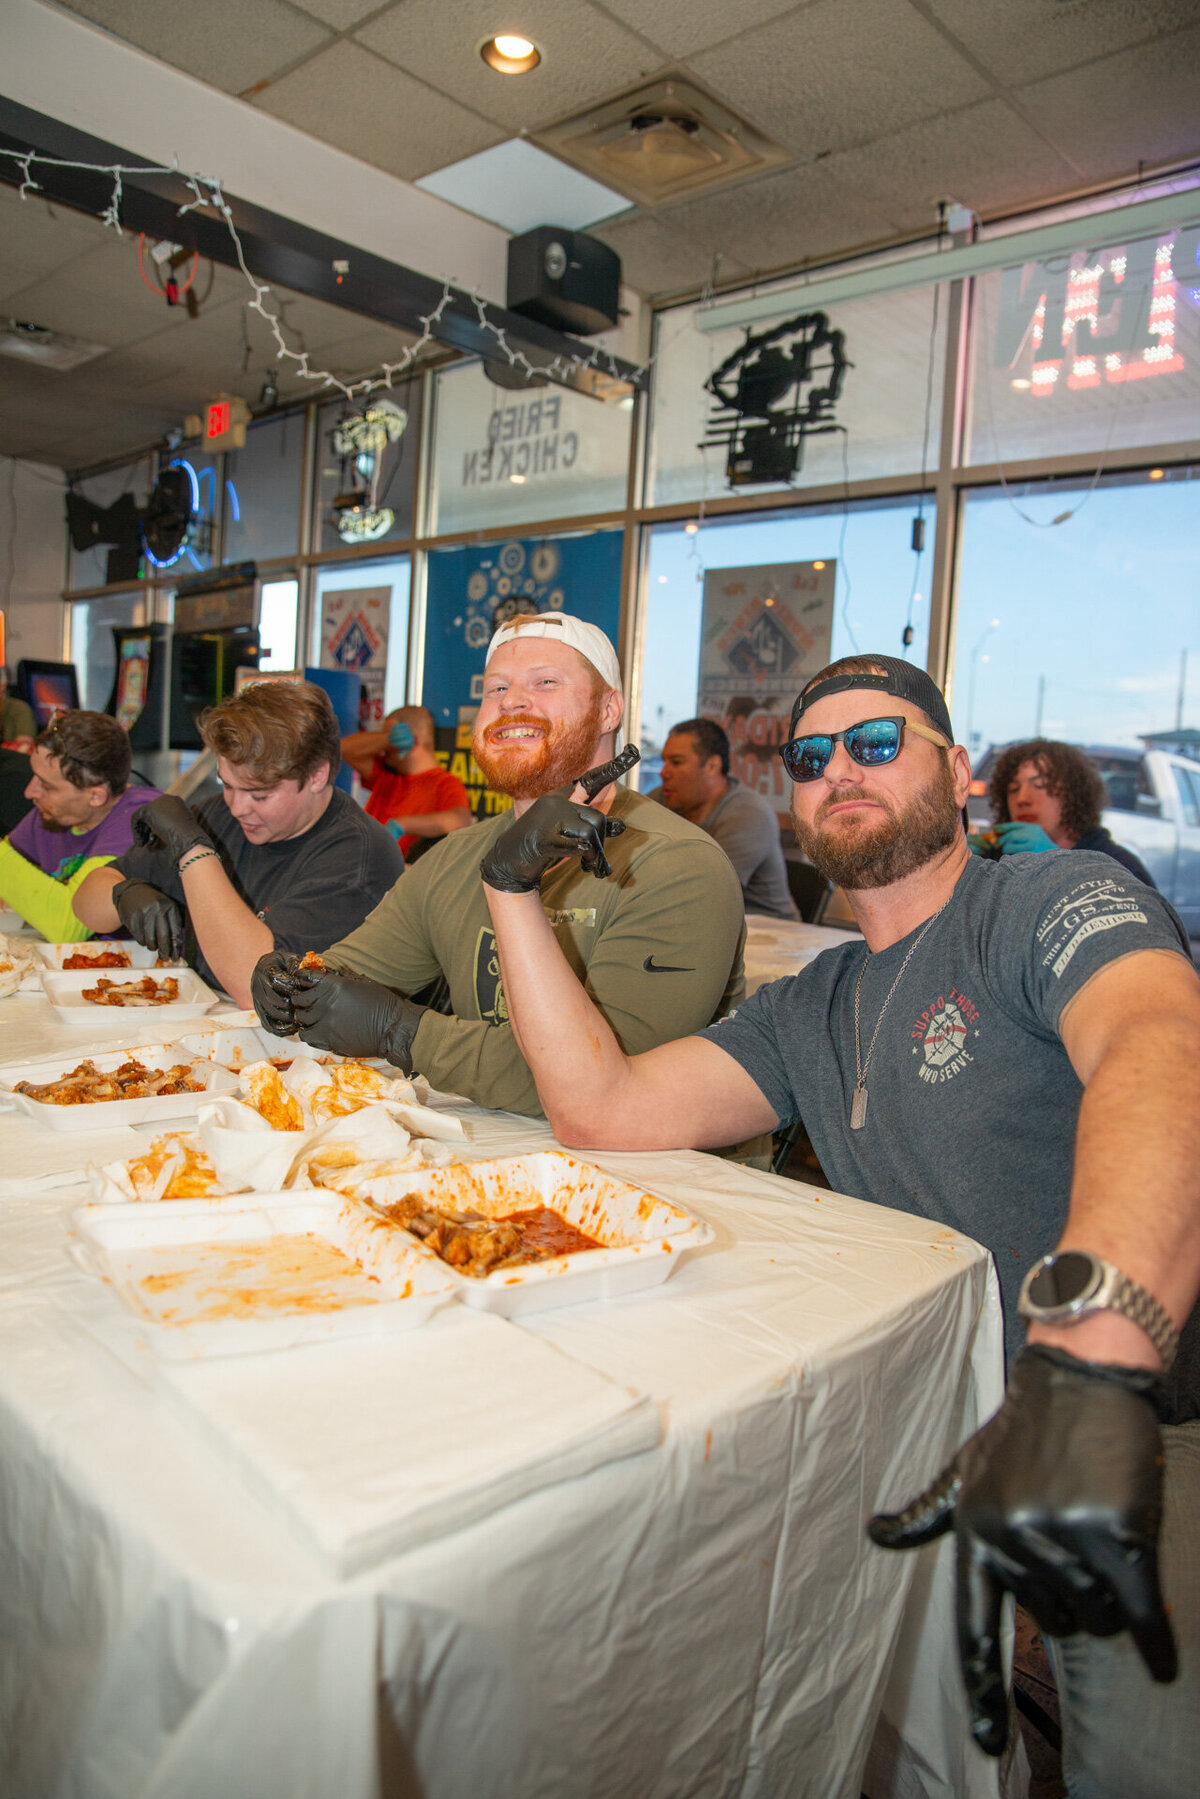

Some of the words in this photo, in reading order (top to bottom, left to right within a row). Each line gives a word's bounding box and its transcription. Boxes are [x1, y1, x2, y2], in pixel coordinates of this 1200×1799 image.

[1042, 942, 1062, 967] THIS
[949, 987, 979, 1024] THOSE
[918, 1063, 938, 1084] WHO
[940, 1050, 975, 1083] SERVE
